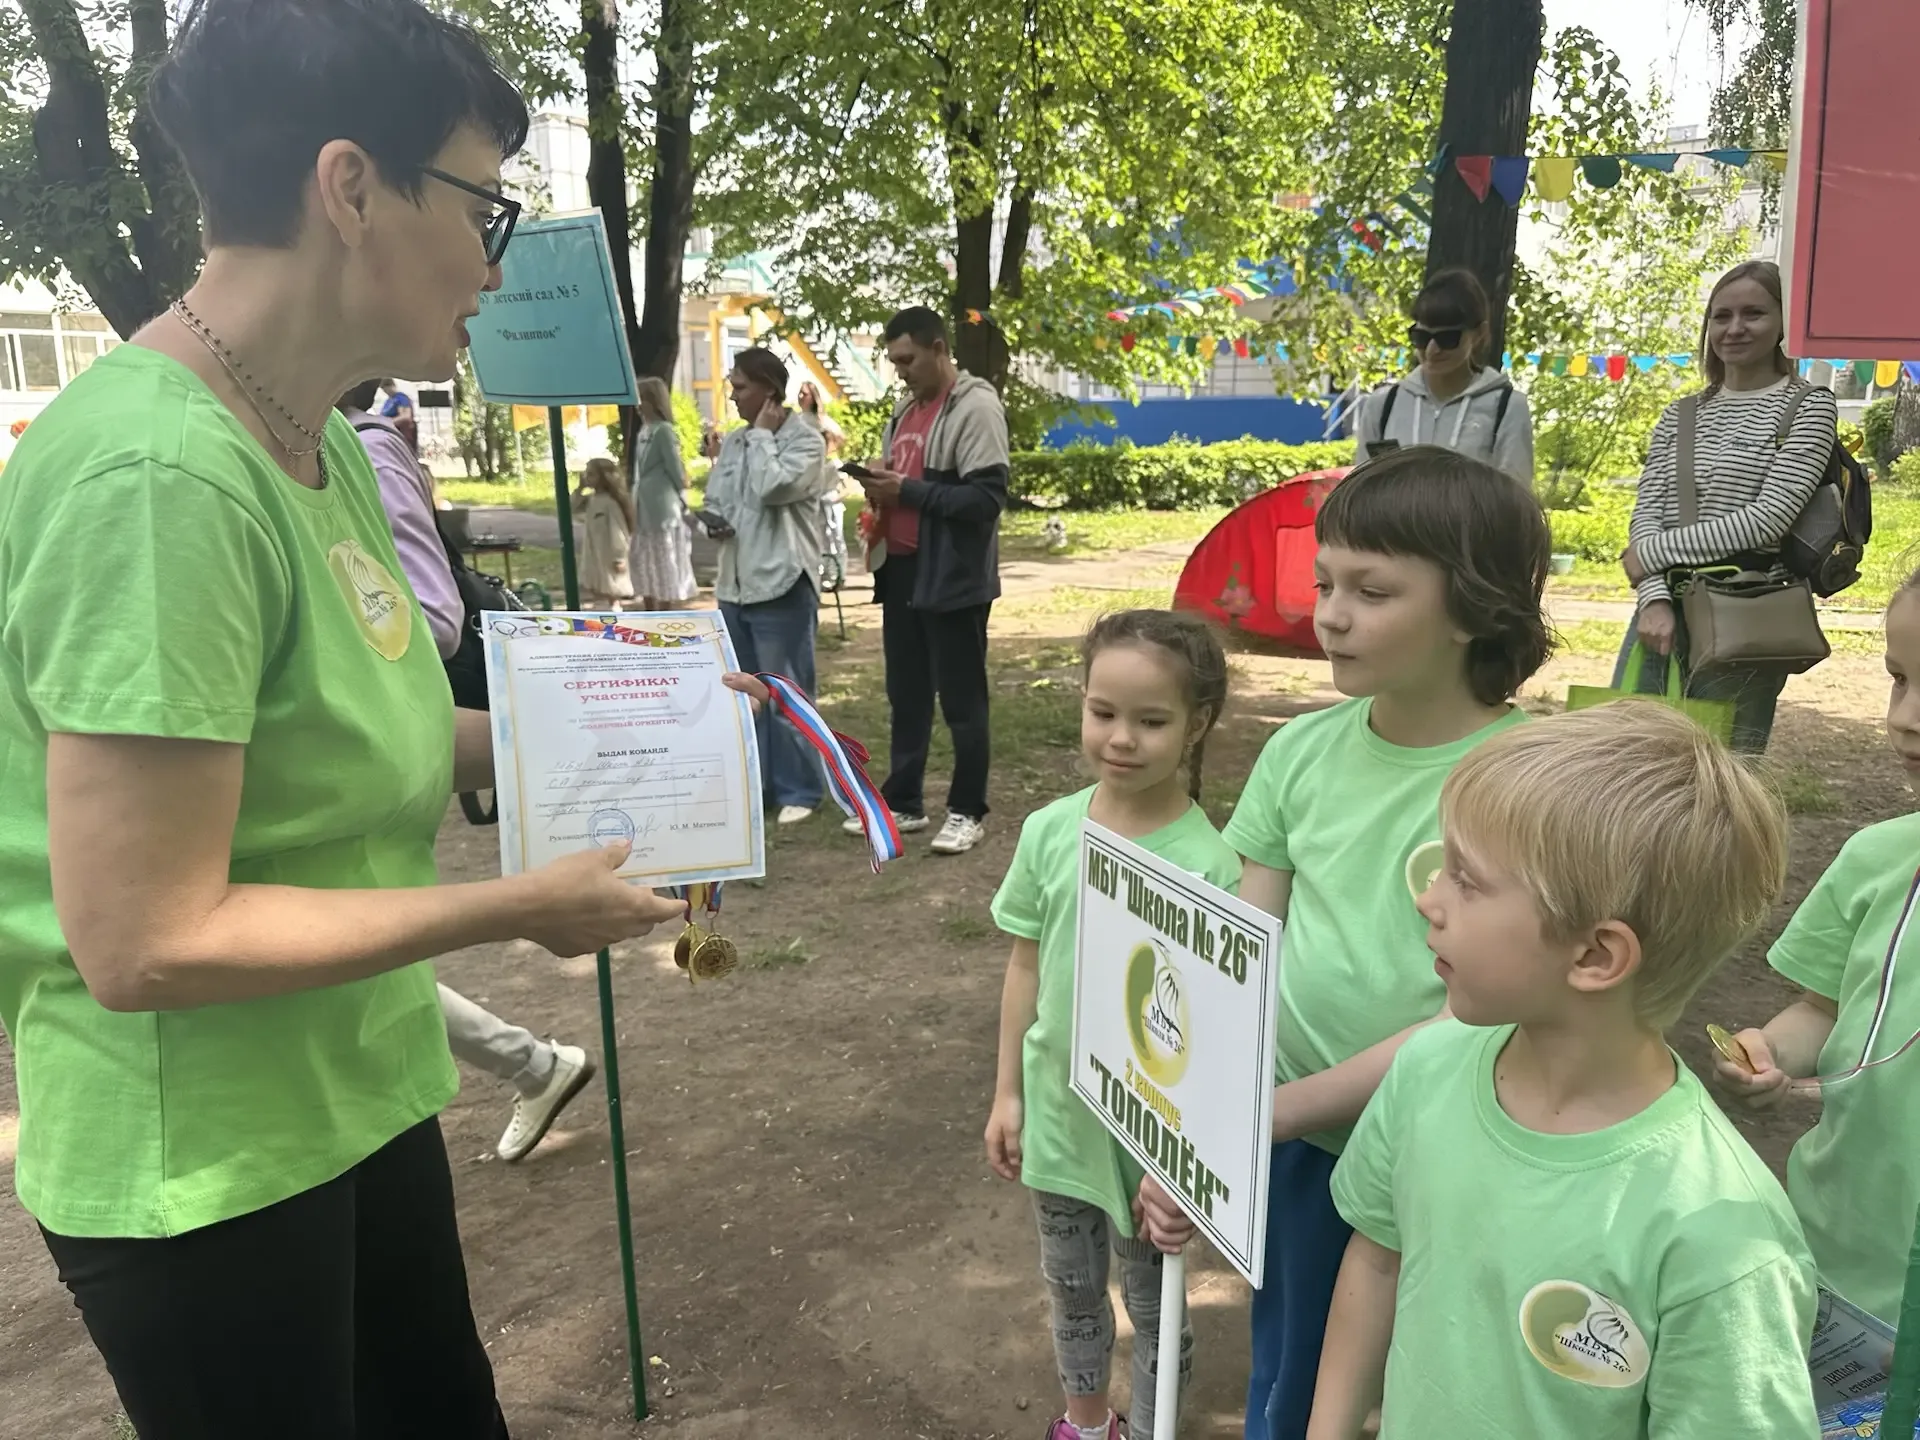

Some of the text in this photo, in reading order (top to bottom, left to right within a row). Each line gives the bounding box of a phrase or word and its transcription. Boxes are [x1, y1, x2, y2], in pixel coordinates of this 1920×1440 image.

[535, 290, 554, 301] сад
[557, 285, 570, 298] №
[571, 284, 580, 298] 5
[564, 677, 680, 690] СЕРТИФИКАТ
[580, 690, 669, 704] участника
[597, 747, 669, 758] ВЫДАН КОМАНДЕ
[1088, 847, 1260, 985] МБУ "Школа № 26"
[1150, 1005, 1172, 1032] МБУ
[1165, 1034, 1173, 1048] №
[1125, 1058, 1181, 1132] 2 корпус
[1090, 1053, 1230, 1221] "ТОПОЛЁК"
[1573, 1332, 1611, 1354] МБУ
[1598, 1353, 1611, 1364] №
[1822, 1360, 1866, 1387] ДИПЛОМ
[1849, 1372, 1889, 1395] степени
